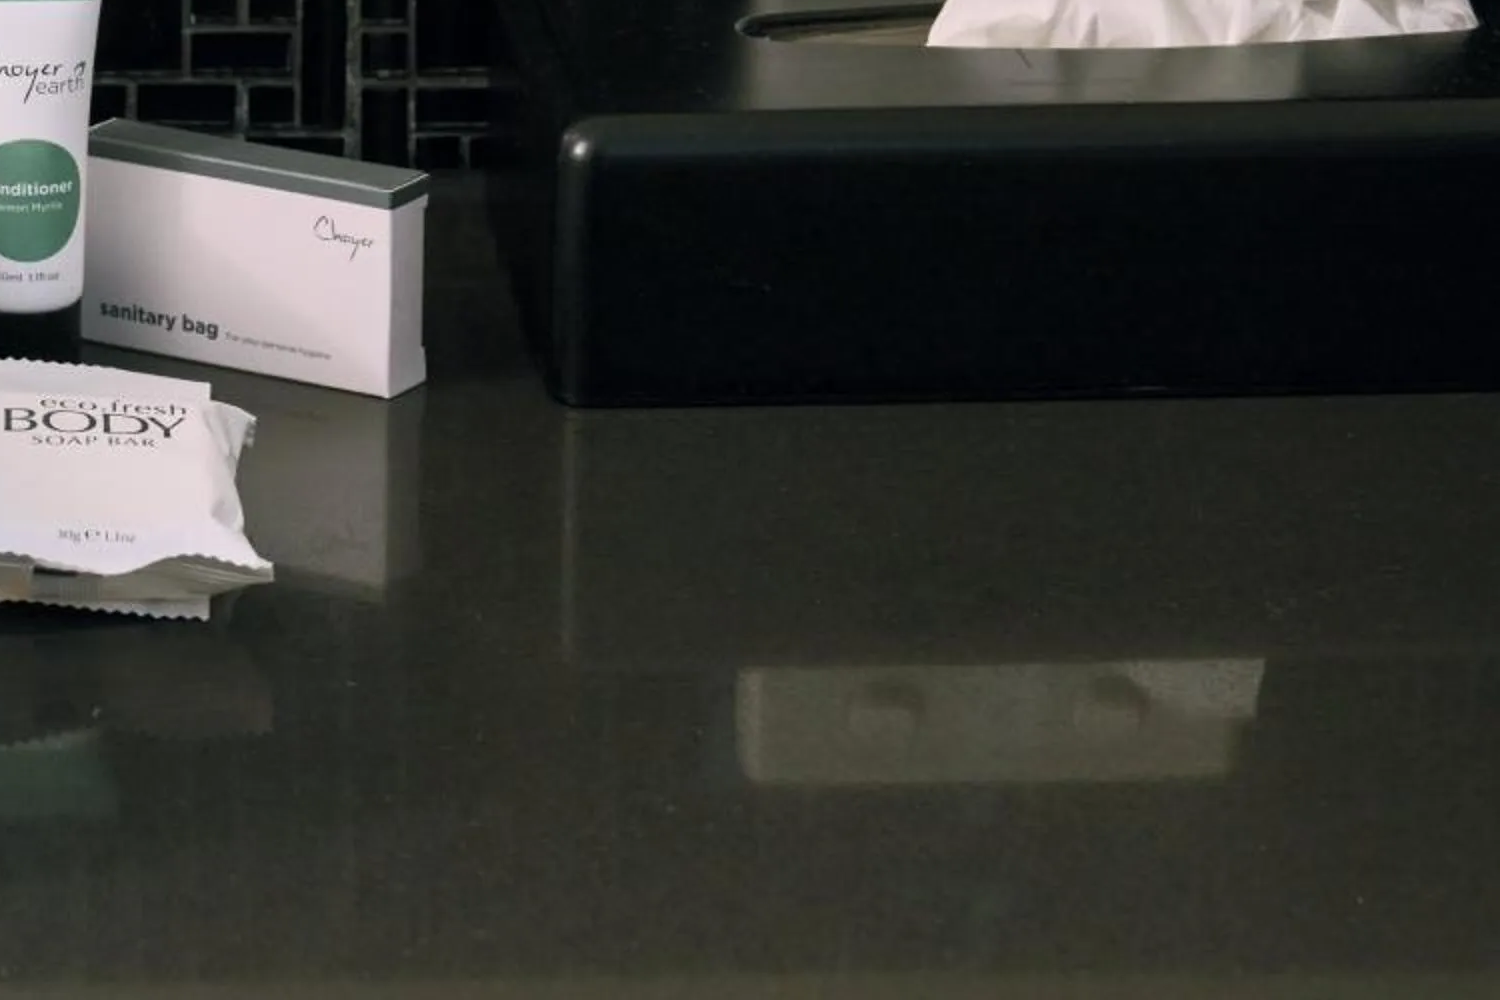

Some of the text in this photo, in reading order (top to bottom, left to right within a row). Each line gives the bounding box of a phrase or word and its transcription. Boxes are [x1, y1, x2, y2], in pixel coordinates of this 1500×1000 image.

[35, 76, 86, 95] earth
[99, 301, 219, 341] sanitary bag
[40, 399, 187, 416] eco fresh
[3, 407, 186, 439] BODY
[31, 435, 156, 448] SOAP BAR
